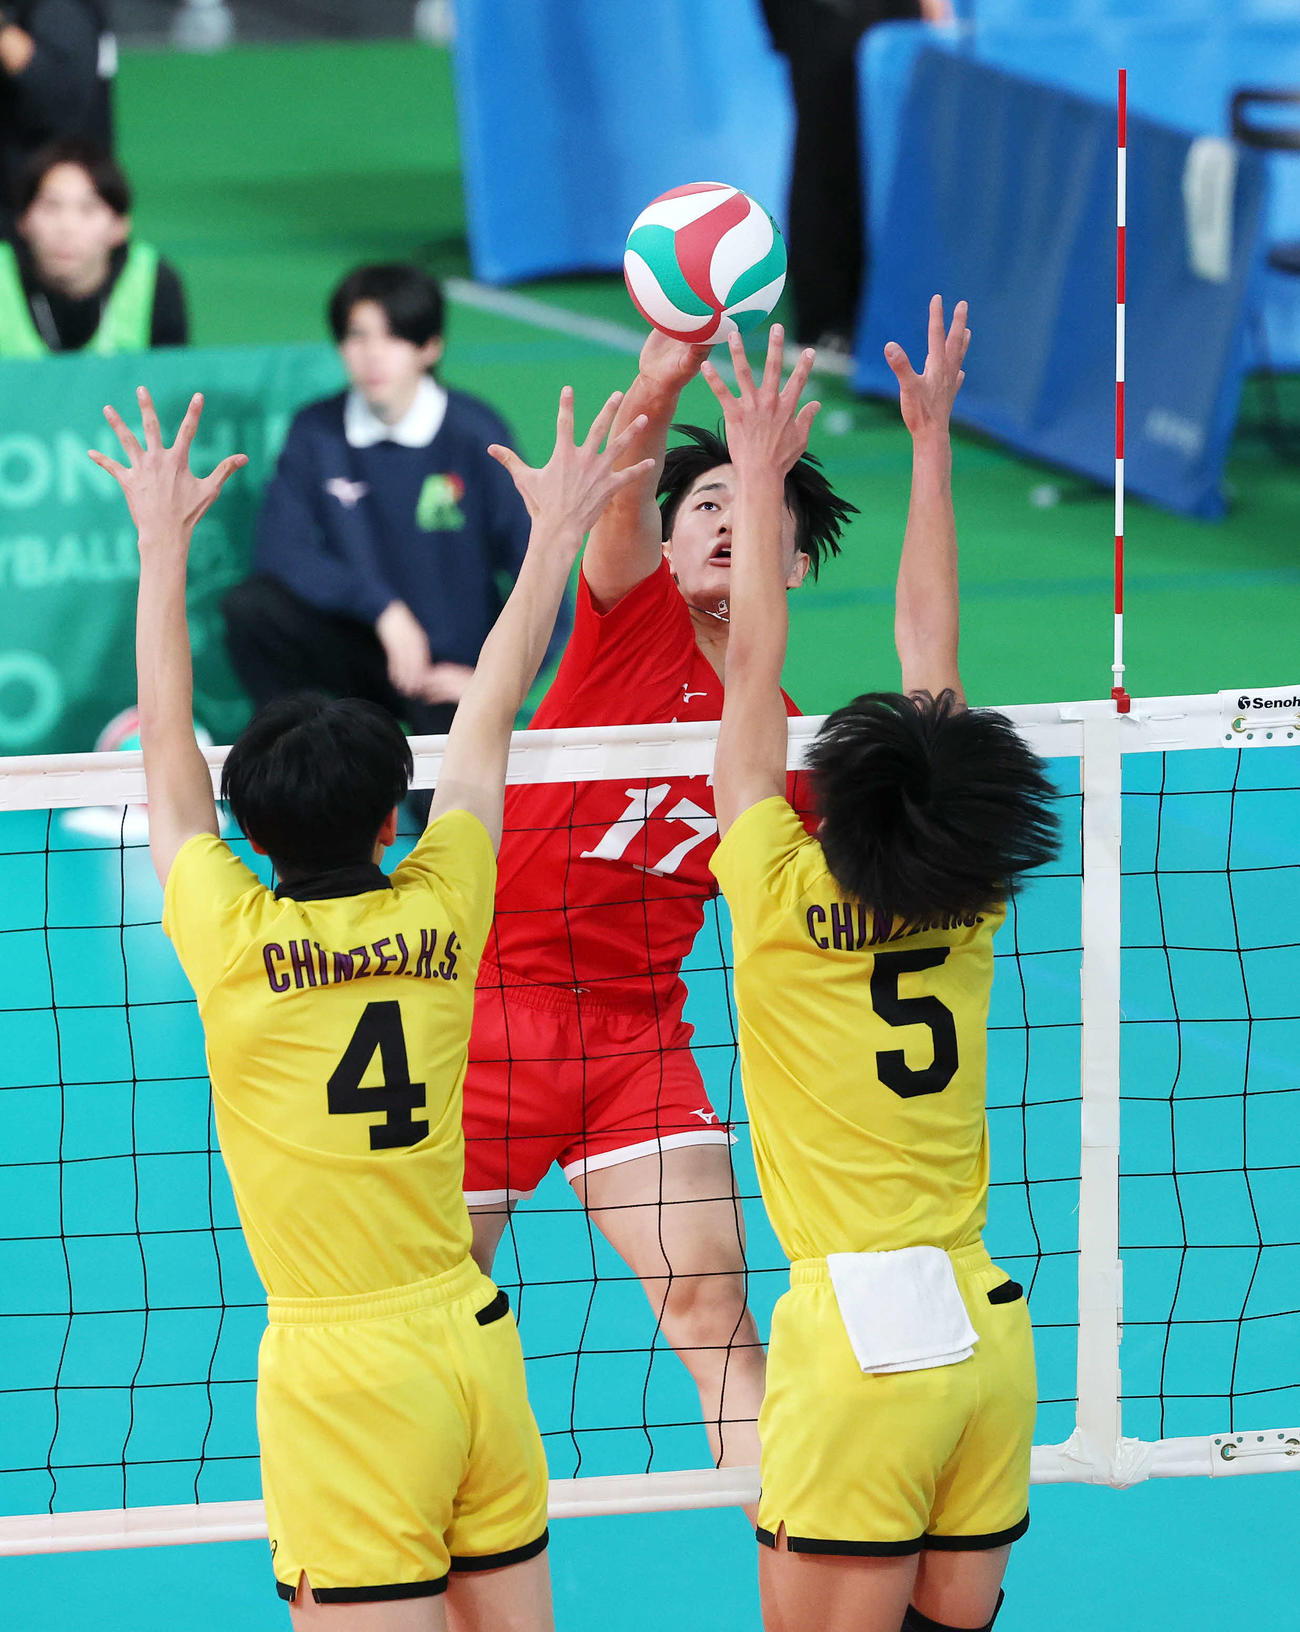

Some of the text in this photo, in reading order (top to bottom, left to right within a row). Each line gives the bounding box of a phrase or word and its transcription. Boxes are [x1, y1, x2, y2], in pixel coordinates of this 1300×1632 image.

[580, 783, 718, 874] 17
[326, 1000, 430, 1151] 4
[870, 946, 959, 1099] 5
